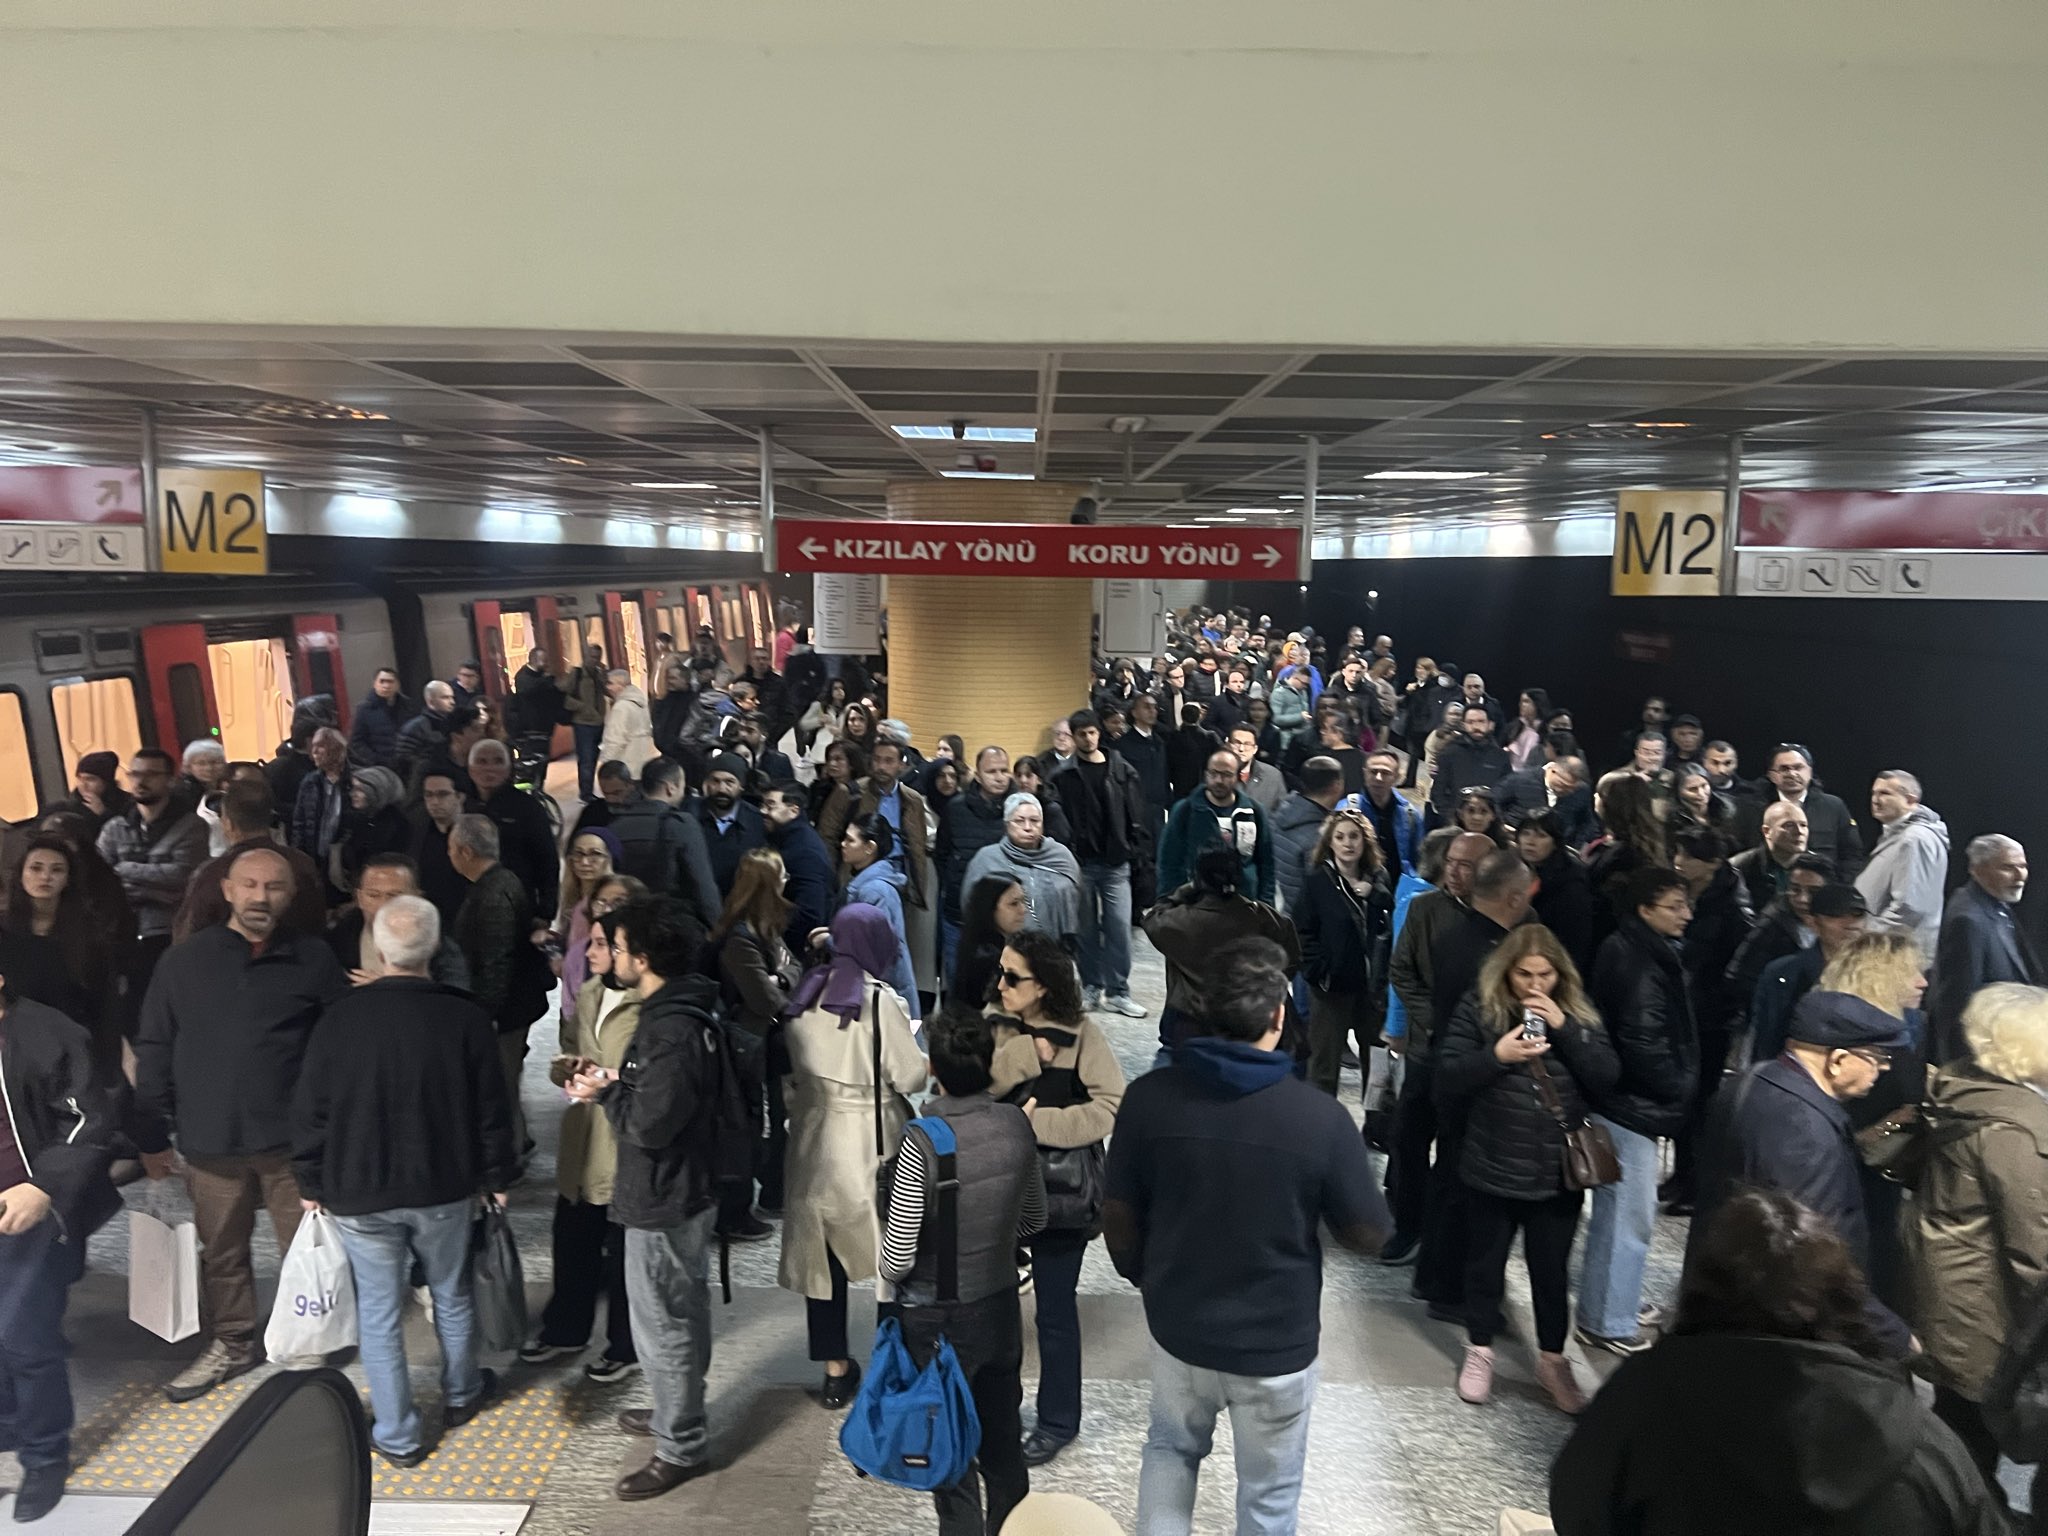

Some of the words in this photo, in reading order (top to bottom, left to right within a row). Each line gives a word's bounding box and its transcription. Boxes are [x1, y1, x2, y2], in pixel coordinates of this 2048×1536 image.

[165, 490, 259, 553] M2
[1622, 511, 1715, 575] M2
[833, 538, 948, 561] KIZILAY
[956, 538, 1036, 563] YÖNÜ
[1068, 544, 1149, 564] KORU
[1158, 542, 1240, 566] YÖNÜ
